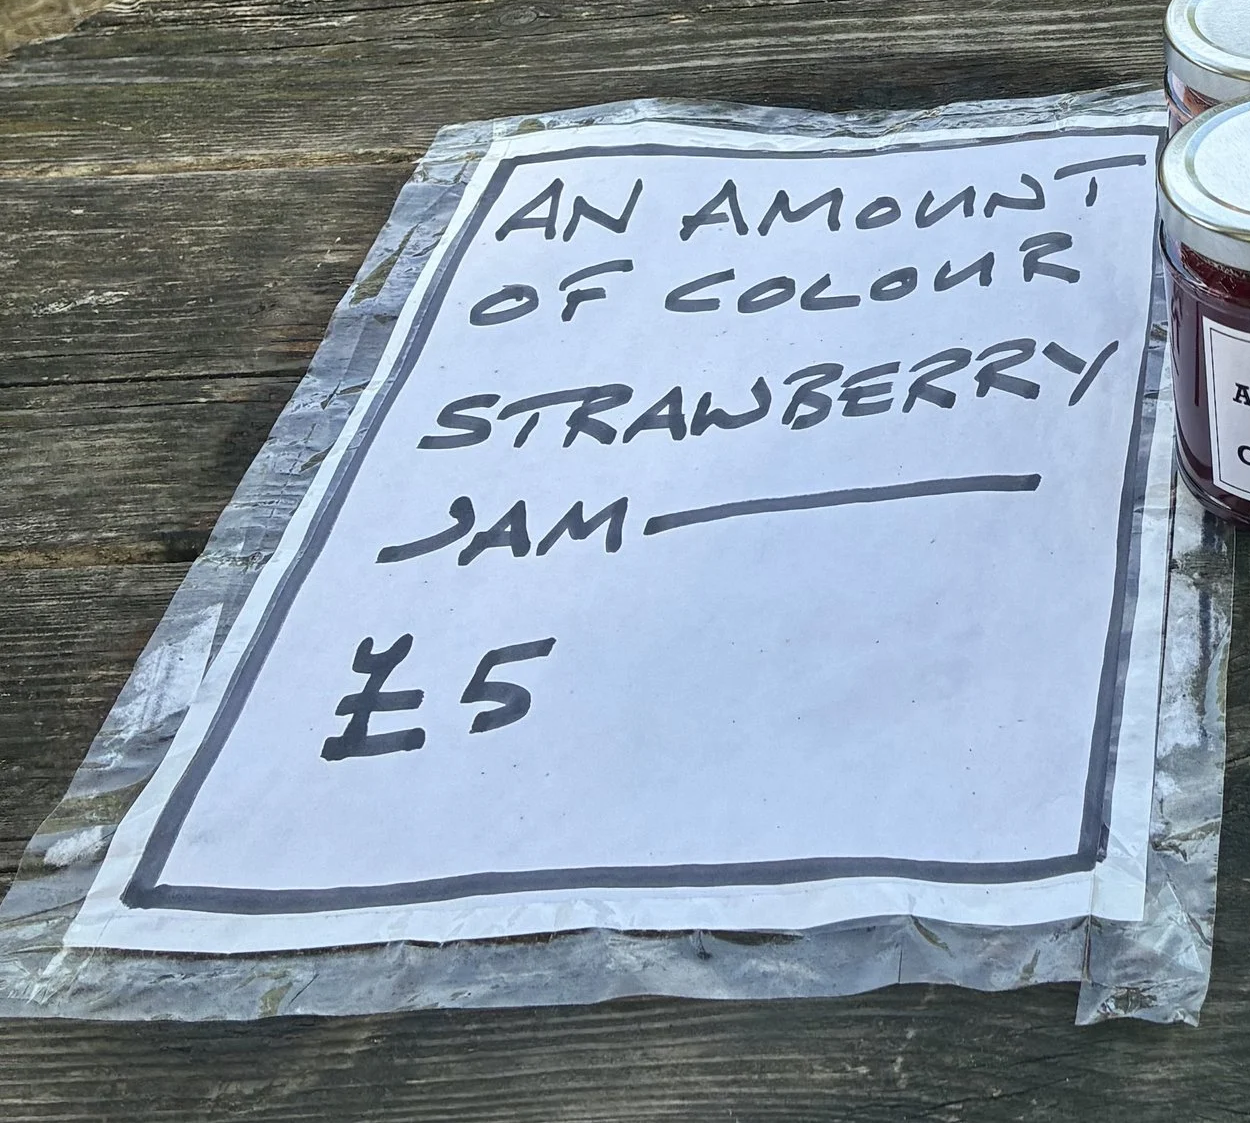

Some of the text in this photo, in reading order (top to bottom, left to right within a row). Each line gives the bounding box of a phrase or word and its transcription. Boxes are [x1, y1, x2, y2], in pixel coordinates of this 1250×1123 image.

[494, 154, 1147, 243] AN AMOUNT
[469, 231, 1081, 327] OF COLOUR
[416, 337, 1120, 450] STRAWBERRY
[374, 495, 629, 567] JAM
[319, 633, 557, 762] £5
